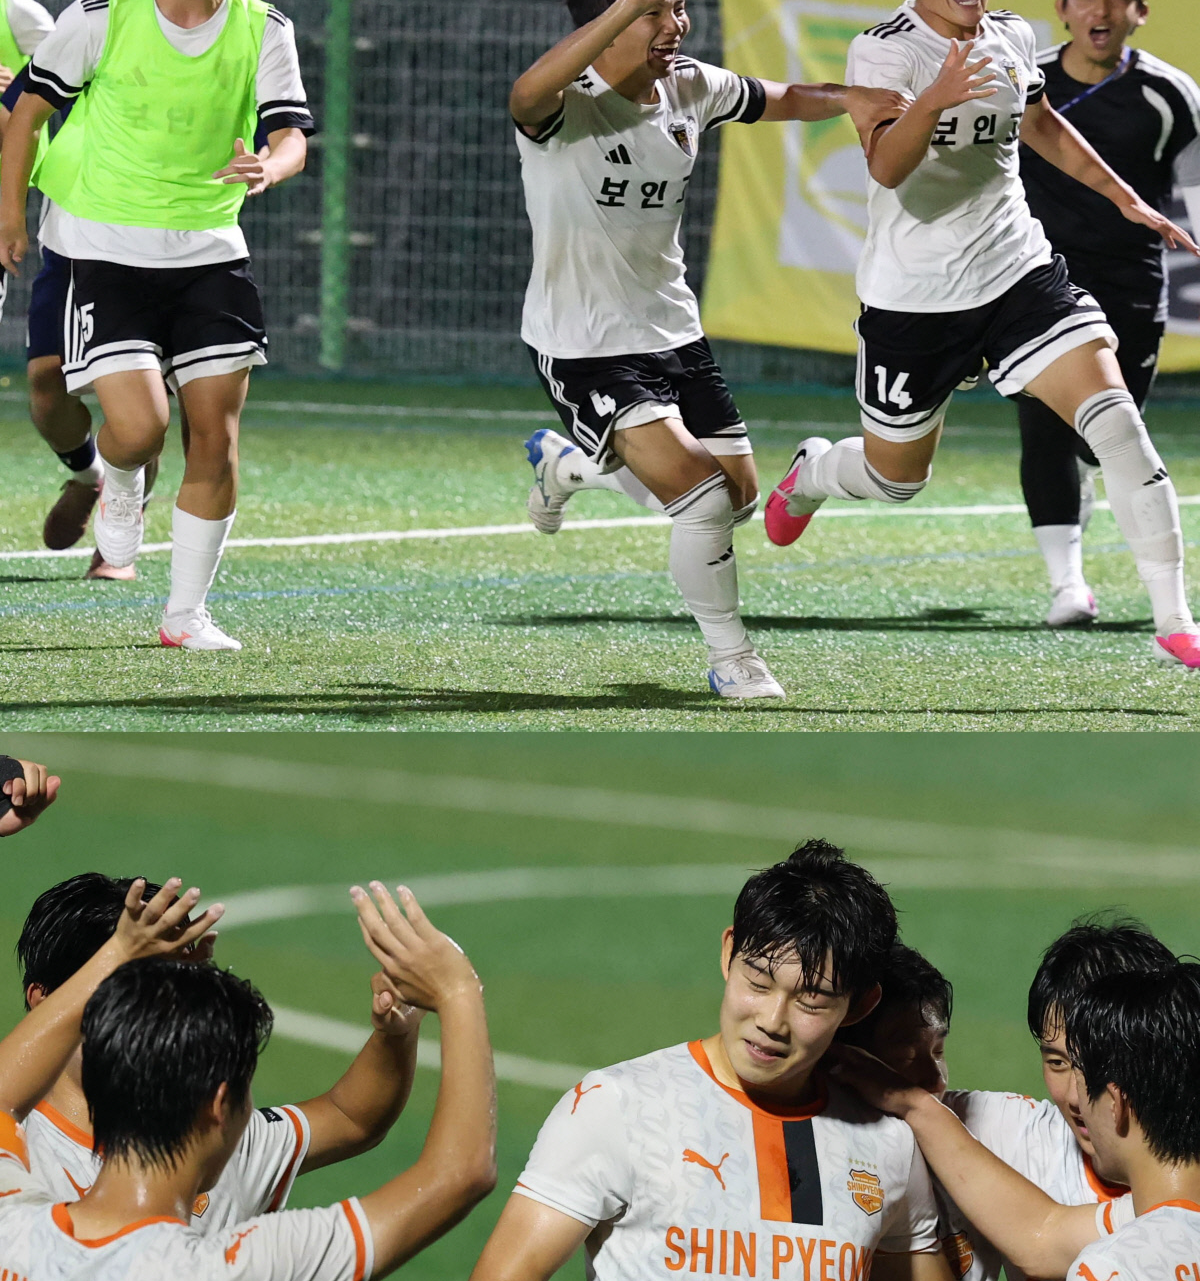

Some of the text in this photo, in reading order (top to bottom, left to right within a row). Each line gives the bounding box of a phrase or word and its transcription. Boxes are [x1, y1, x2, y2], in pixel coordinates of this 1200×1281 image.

[589, 389, 617, 417] 4
[874, 365, 913, 410] 14
[664, 1225, 757, 1278] SHIN
